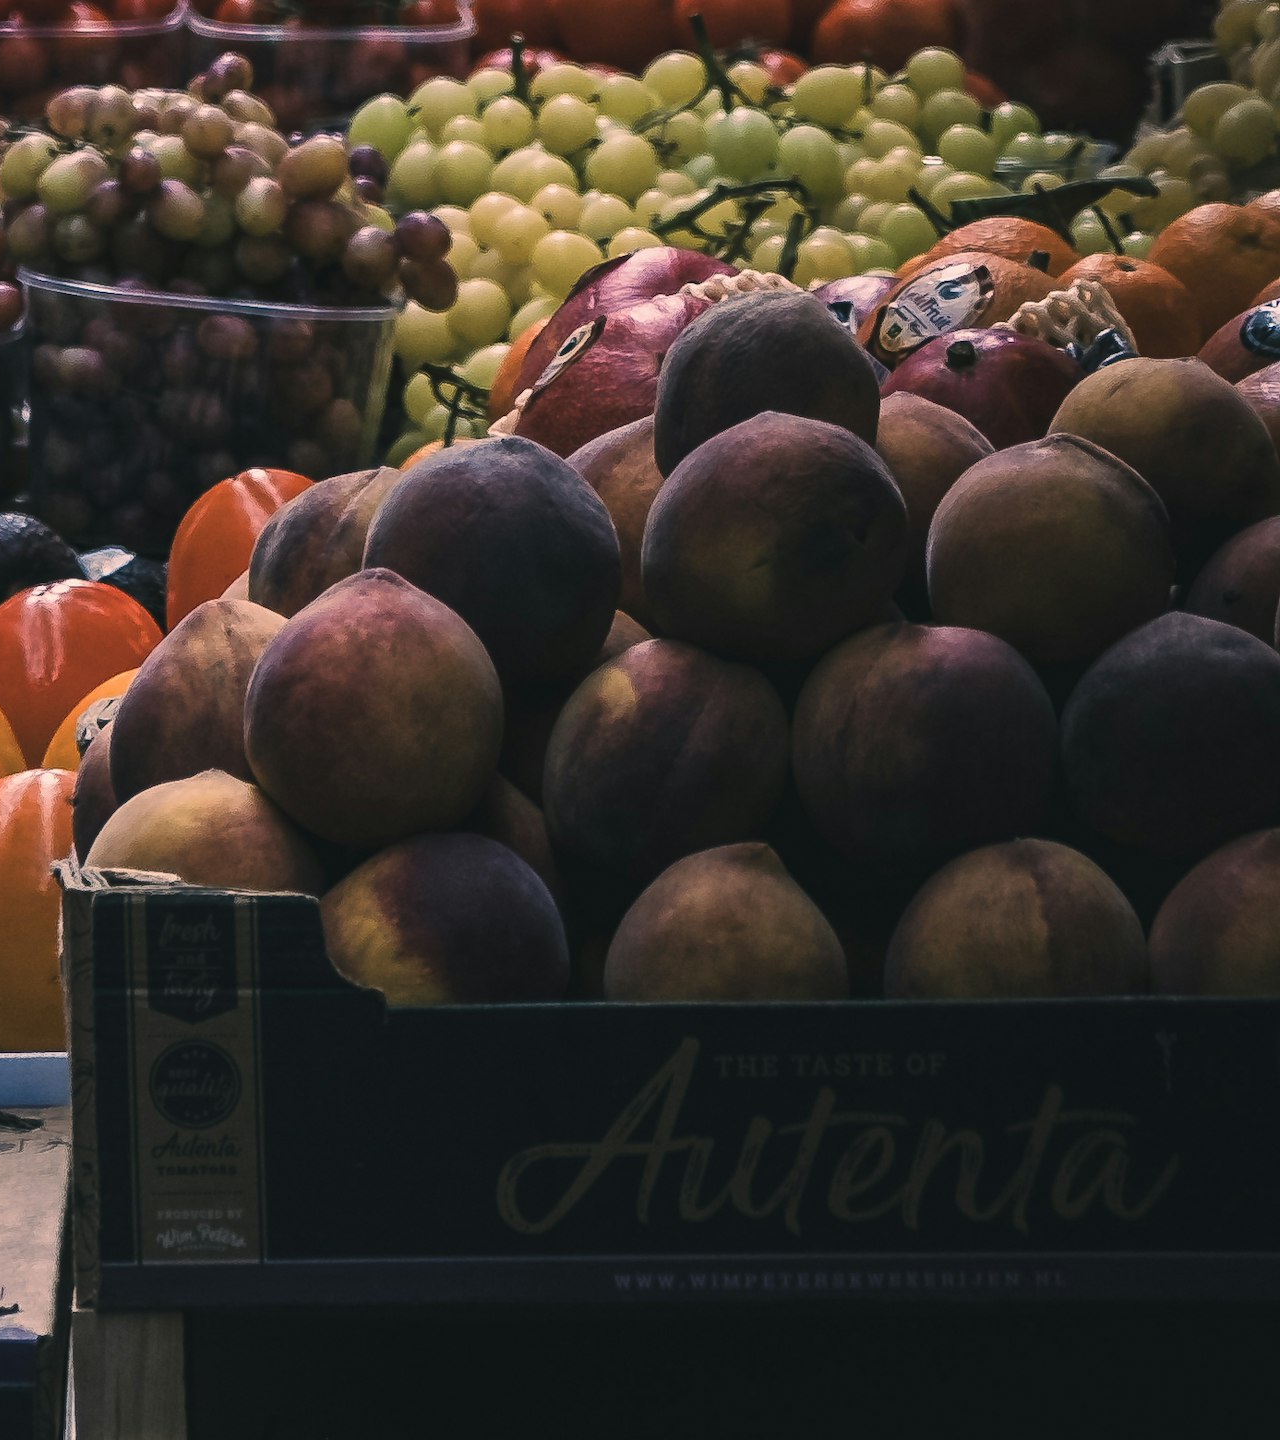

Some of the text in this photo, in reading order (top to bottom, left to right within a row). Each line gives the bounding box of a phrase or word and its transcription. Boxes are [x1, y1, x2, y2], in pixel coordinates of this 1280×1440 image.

[158, 913, 223, 946] fresh
[176, 952, 207, 966] and
[714, 1052, 948, 1078] THE TASTE OF
[159, 1072, 232, 1111] quality
[151, 1131, 242, 1159] Autenta
[496, 1035, 1181, 1237] Autenta
[157, 1209, 243, 1221] PRODUCED BY
